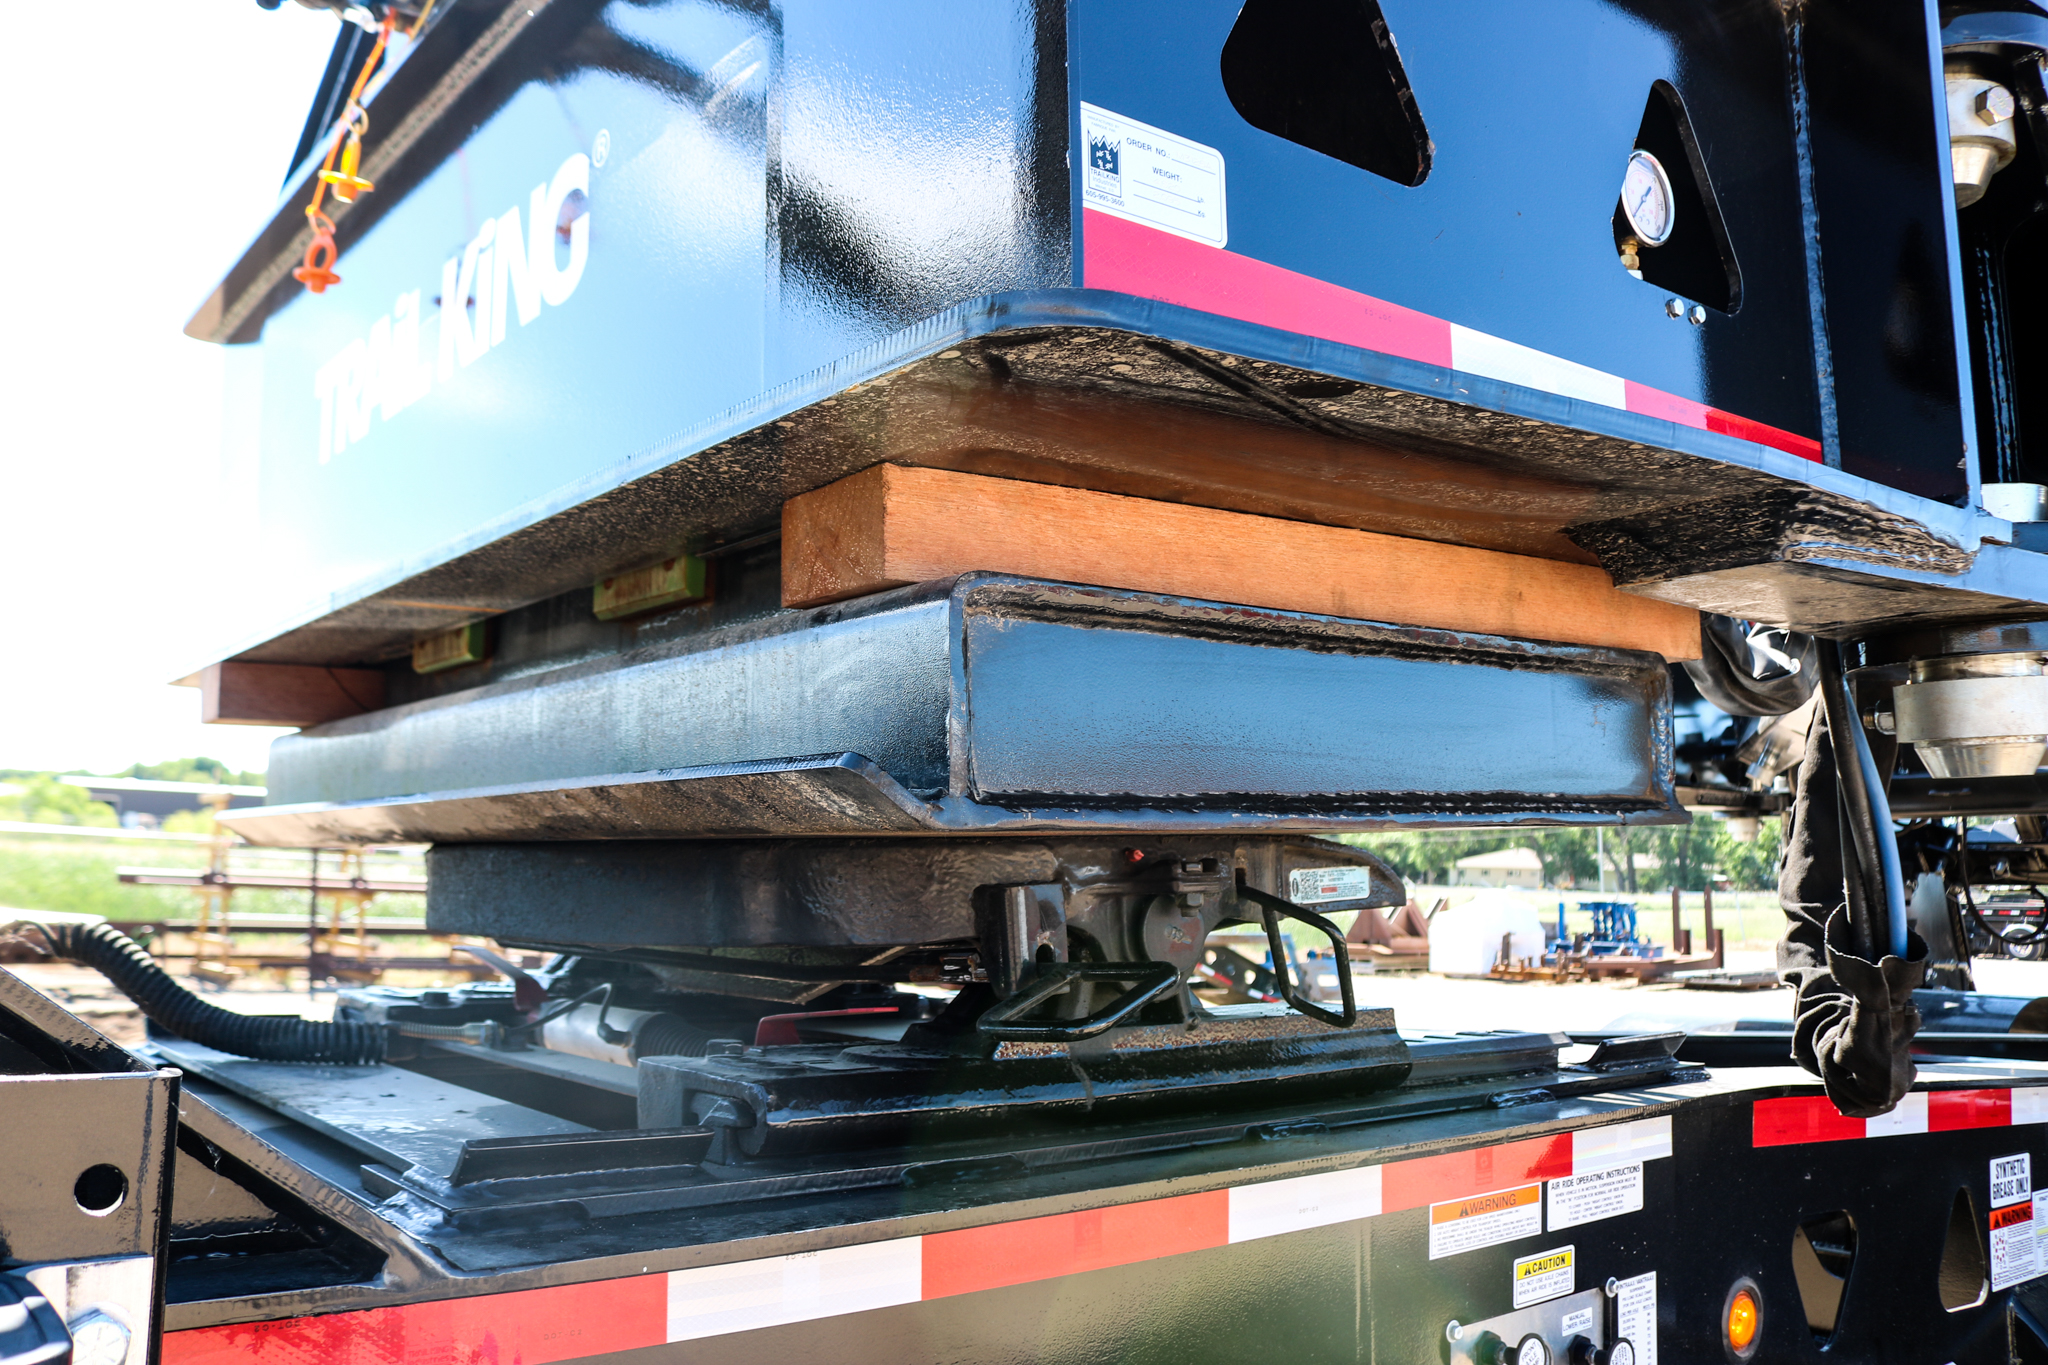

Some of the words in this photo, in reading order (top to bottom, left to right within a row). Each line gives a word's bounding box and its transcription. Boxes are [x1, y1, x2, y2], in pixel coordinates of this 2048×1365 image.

[1126, 137, 1152, 153] ORDER
[1152, 166, 1182, 183] WEIGHT:
[1551, 1182, 1560, 1190] AIR
[1562, 1179, 1574, 1188] RIDE
[1576, 1173, 1604, 1185] OPERATING
[1606, 1165, 1640, 1179] INSTRUCTIONS
[1996, 1158, 2025, 1180] SYNTHETIC
[1993, 1180, 2014, 1200] GREASE
[2016, 1176, 2029, 1195] ONLY
[1469, 1193, 1517, 1215] WARNING
[2002, 1206, 2032, 1226] WARNING
[1532, 1255, 1566, 1273] CAUTION
[1554, 1277, 1570, 1286] INFLATED
[1556, 1270, 1569, 1278] CHAINS
[1563, 1322, 1578, 1332] LOWER
[1579, 1317, 1591, 1326] RAISE
[1569, 1312, 1585, 1321] MANUAL
